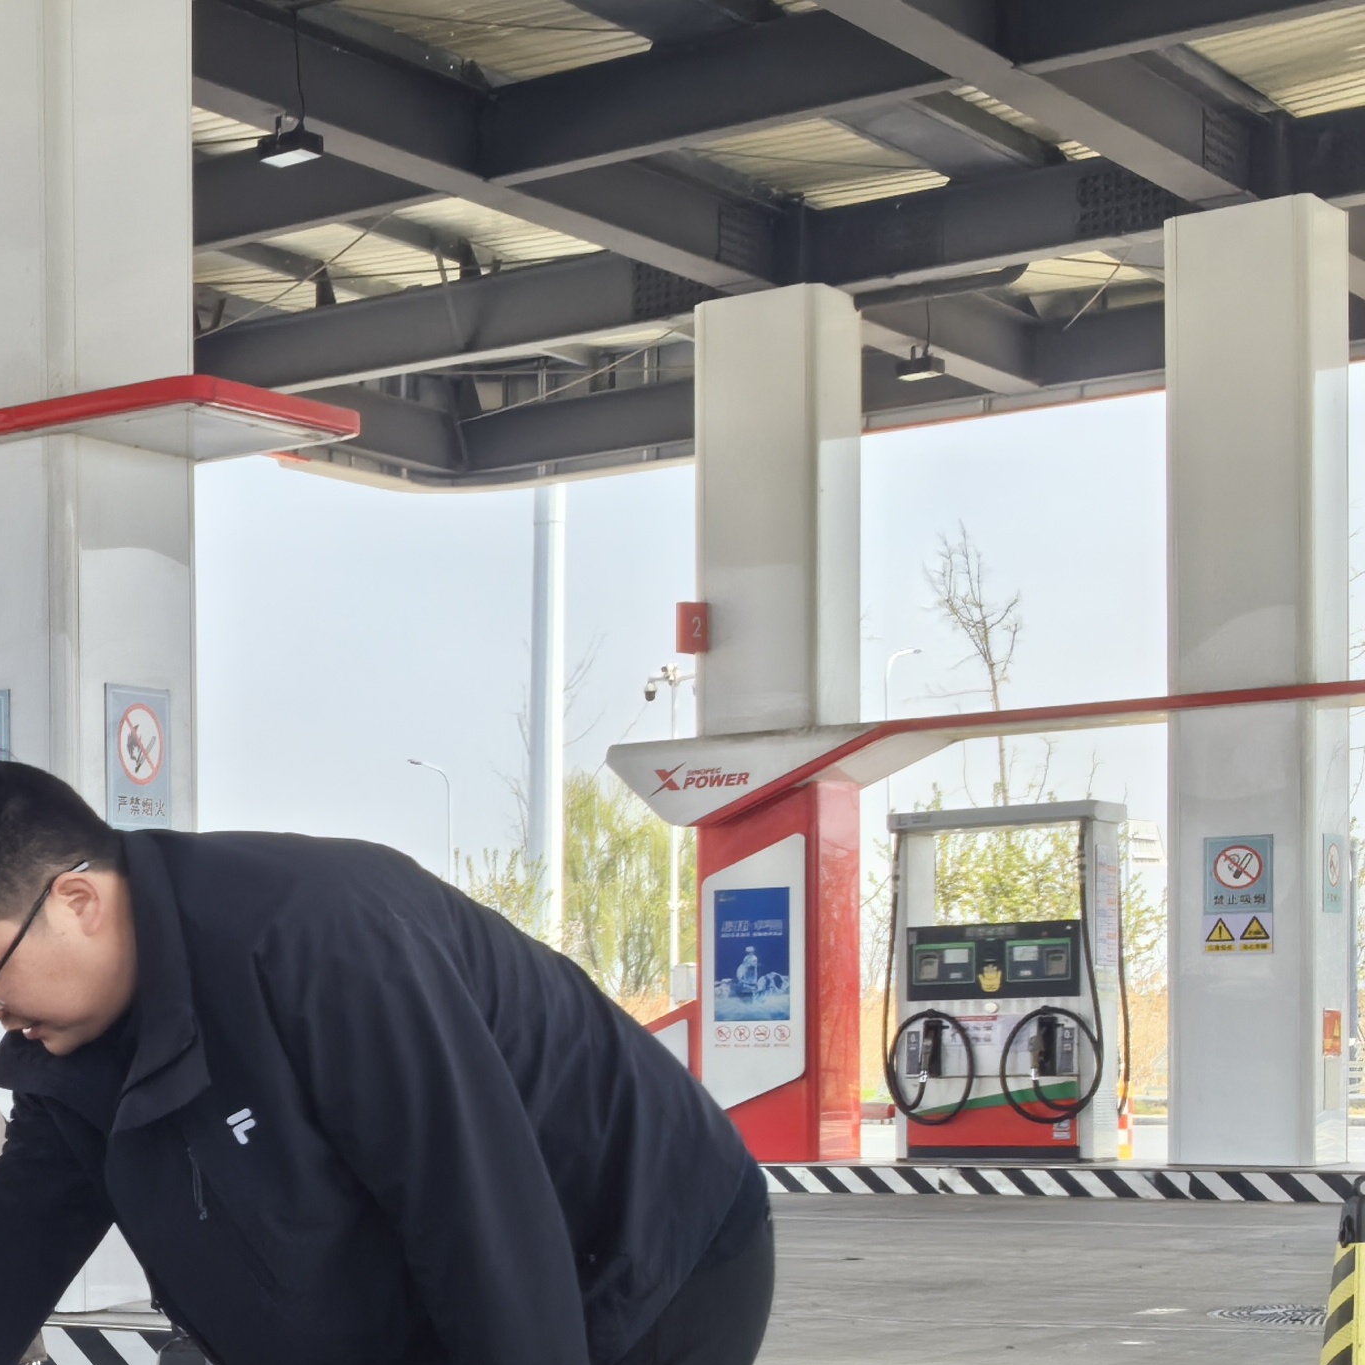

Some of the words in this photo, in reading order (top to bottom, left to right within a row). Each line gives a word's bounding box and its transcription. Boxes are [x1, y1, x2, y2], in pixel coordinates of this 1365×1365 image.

[692, 616, 702, 638] 2
[686, 766, 722, 777] SINOPEC
[683, 772, 750, 790] POWER
[117, 795, 166, 817] 严禁烟火
[1213, 894, 1266, 905] 禁止吸烟
